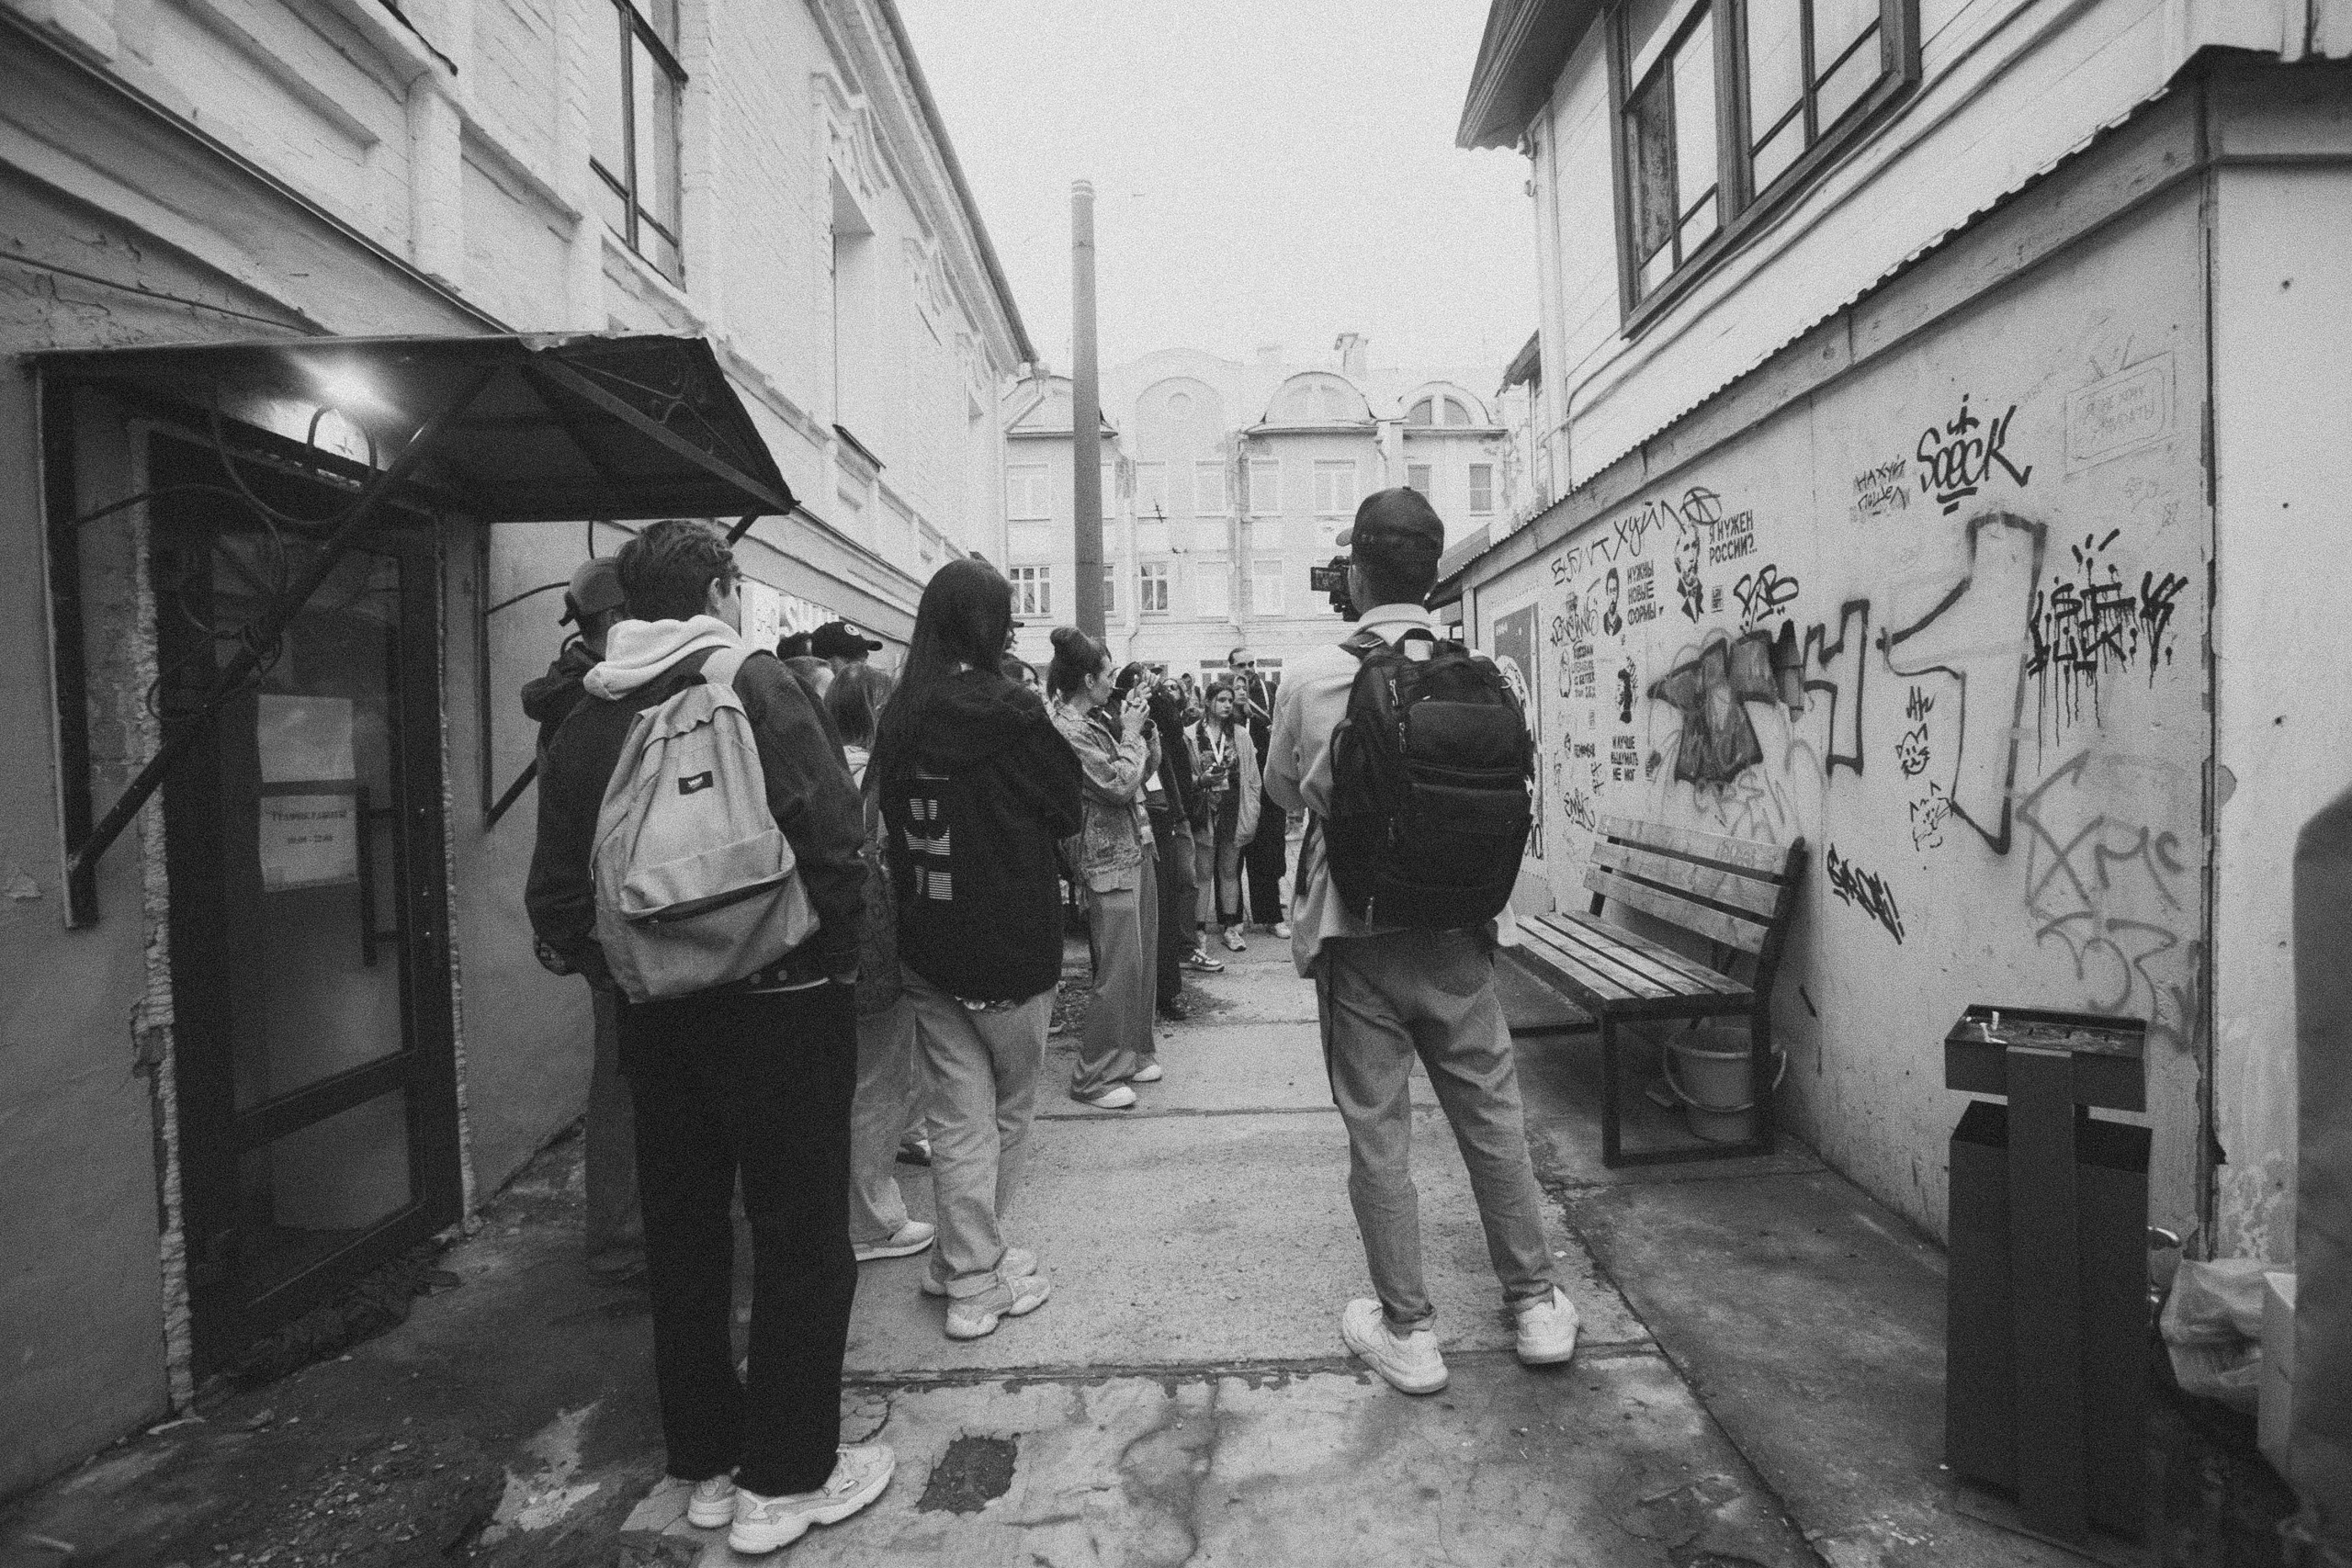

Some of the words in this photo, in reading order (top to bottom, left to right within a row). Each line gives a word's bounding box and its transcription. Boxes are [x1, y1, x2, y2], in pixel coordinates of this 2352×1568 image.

[1717, 510, 1753, 541] НУЖЕН
[1627, 559, 1654, 584] НУЖНЫ
[1628, 580, 1654, 605] НОВЫЕ
